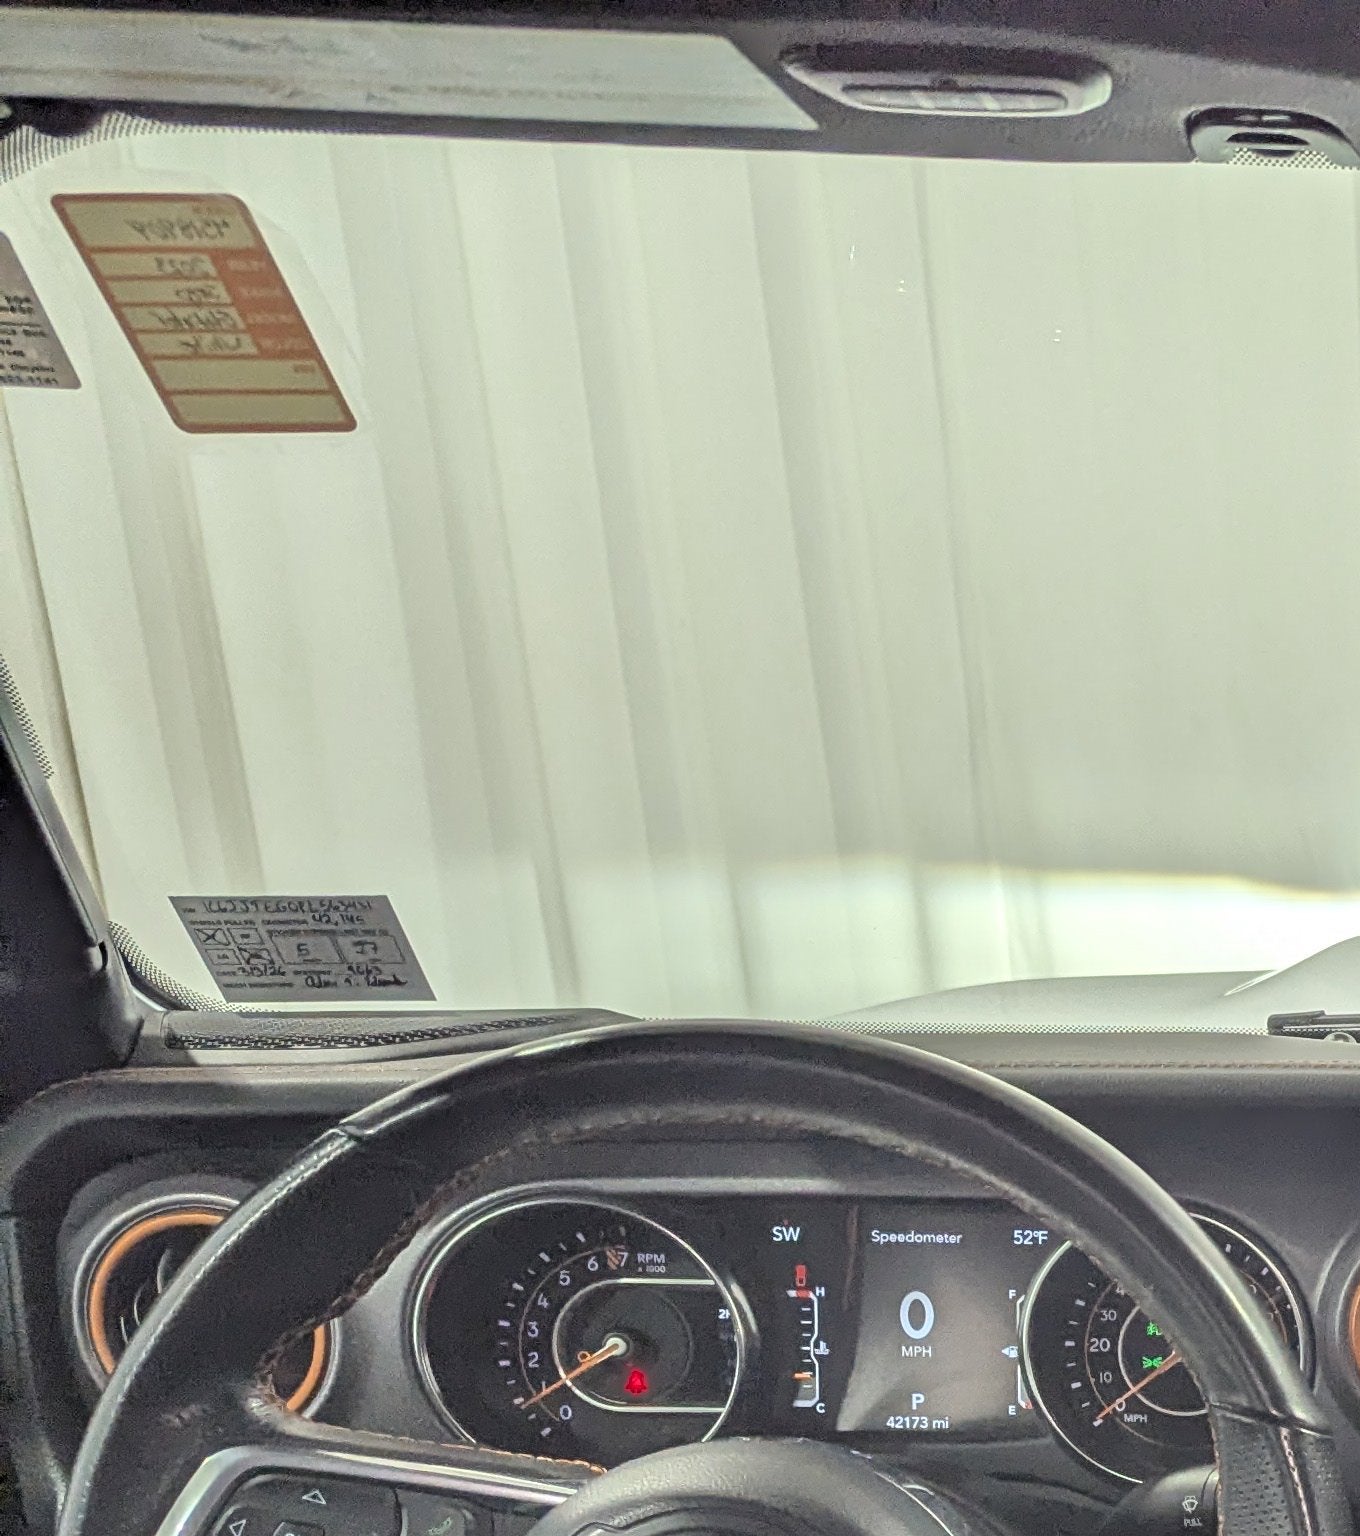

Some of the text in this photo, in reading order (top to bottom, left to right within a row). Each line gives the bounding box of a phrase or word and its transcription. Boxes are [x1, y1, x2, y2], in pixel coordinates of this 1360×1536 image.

[772, 1226, 800, 1242] SW
[871, 1229, 962, 1245] Speedometer
[587, 1256, 599, 1272] 6
[636, 1253, 666, 1264] RPM
[559, 1270, 571, 1286] 5
[815, 1287, 826, 1297] H
[1008, 1290, 1017, 1299] F
[537, 1293, 549, 1308] 4
[899, 1290, 935, 1339] 0
[1100, 1309, 1118, 1322] 30
[527, 1321, 539, 1337] 3
[901, 1346, 932, 1358] MPH
[1089, 1338, 1111, 1353] 20
[527, 1352, 540, 1369] 2
[1098, 1371, 1113, 1384] 10
[815, 1402, 826, 1414] C
[911, 1393, 925, 1410] P
[558, 1404, 573, 1421] 0
[1008, 1405, 1017, 1416] E
[1123, 1412, 1148, 1424] MPH
[886, 1416, 949, 1429] 42173 mi
